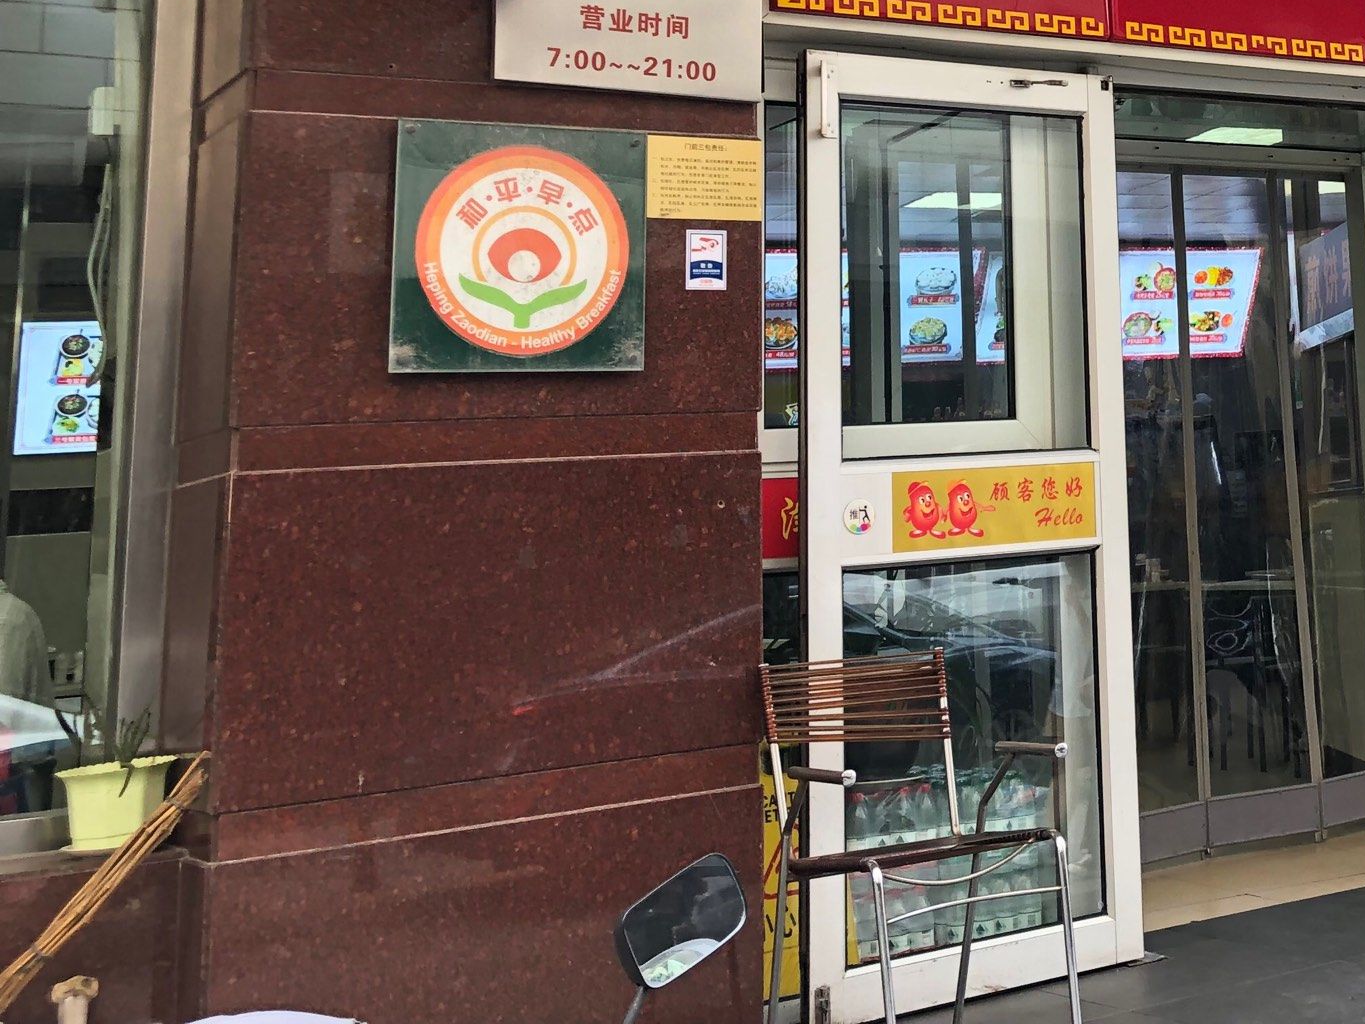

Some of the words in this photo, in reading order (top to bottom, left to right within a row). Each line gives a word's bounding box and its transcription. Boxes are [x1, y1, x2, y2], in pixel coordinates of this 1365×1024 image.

[580, 4, 690, 40] 营业时间
[423, 261, 453, 315] Heping
[450, 309, 508, 348] Zaodian
[520, 326, 577, 350] Healthy
[575, 268, 622, 330] Breakfast
[989, 476, 1083, 502] 顾客您好
[1034, 507, 1084, 529] Hello
